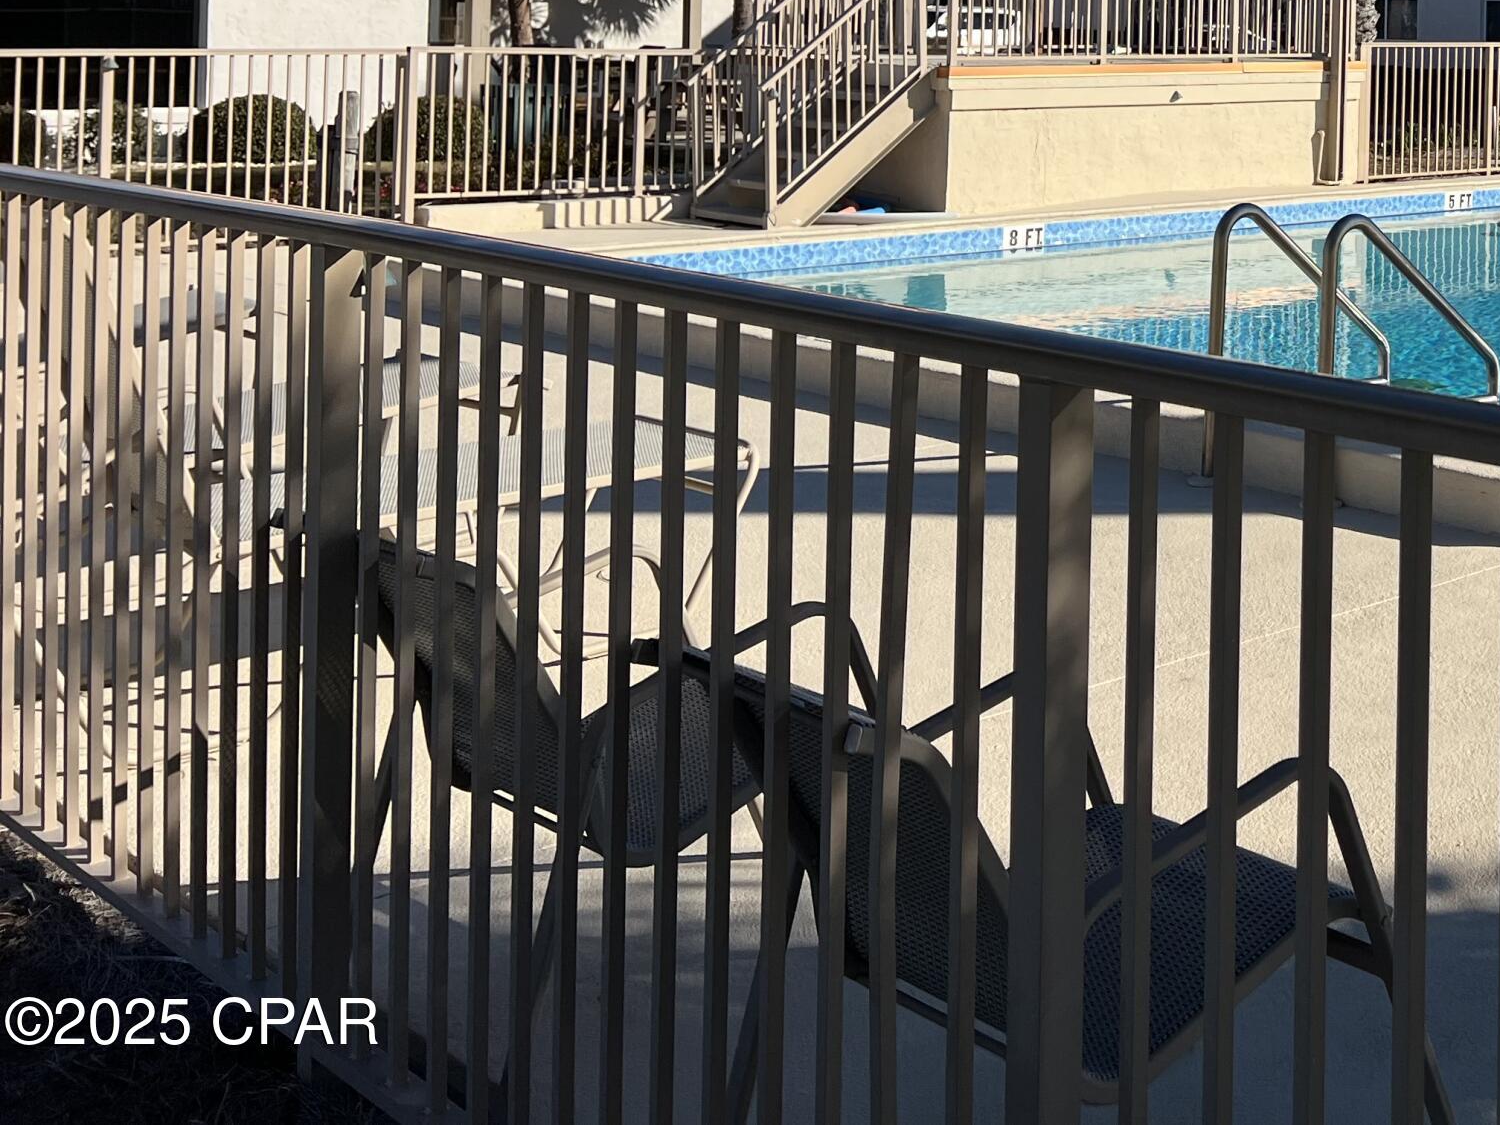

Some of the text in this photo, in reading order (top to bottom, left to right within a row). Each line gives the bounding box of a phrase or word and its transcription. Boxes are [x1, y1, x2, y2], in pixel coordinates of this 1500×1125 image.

[1448, 193, 1472, 209] 5 FT
[1009, 229, 1018, 246] 8
